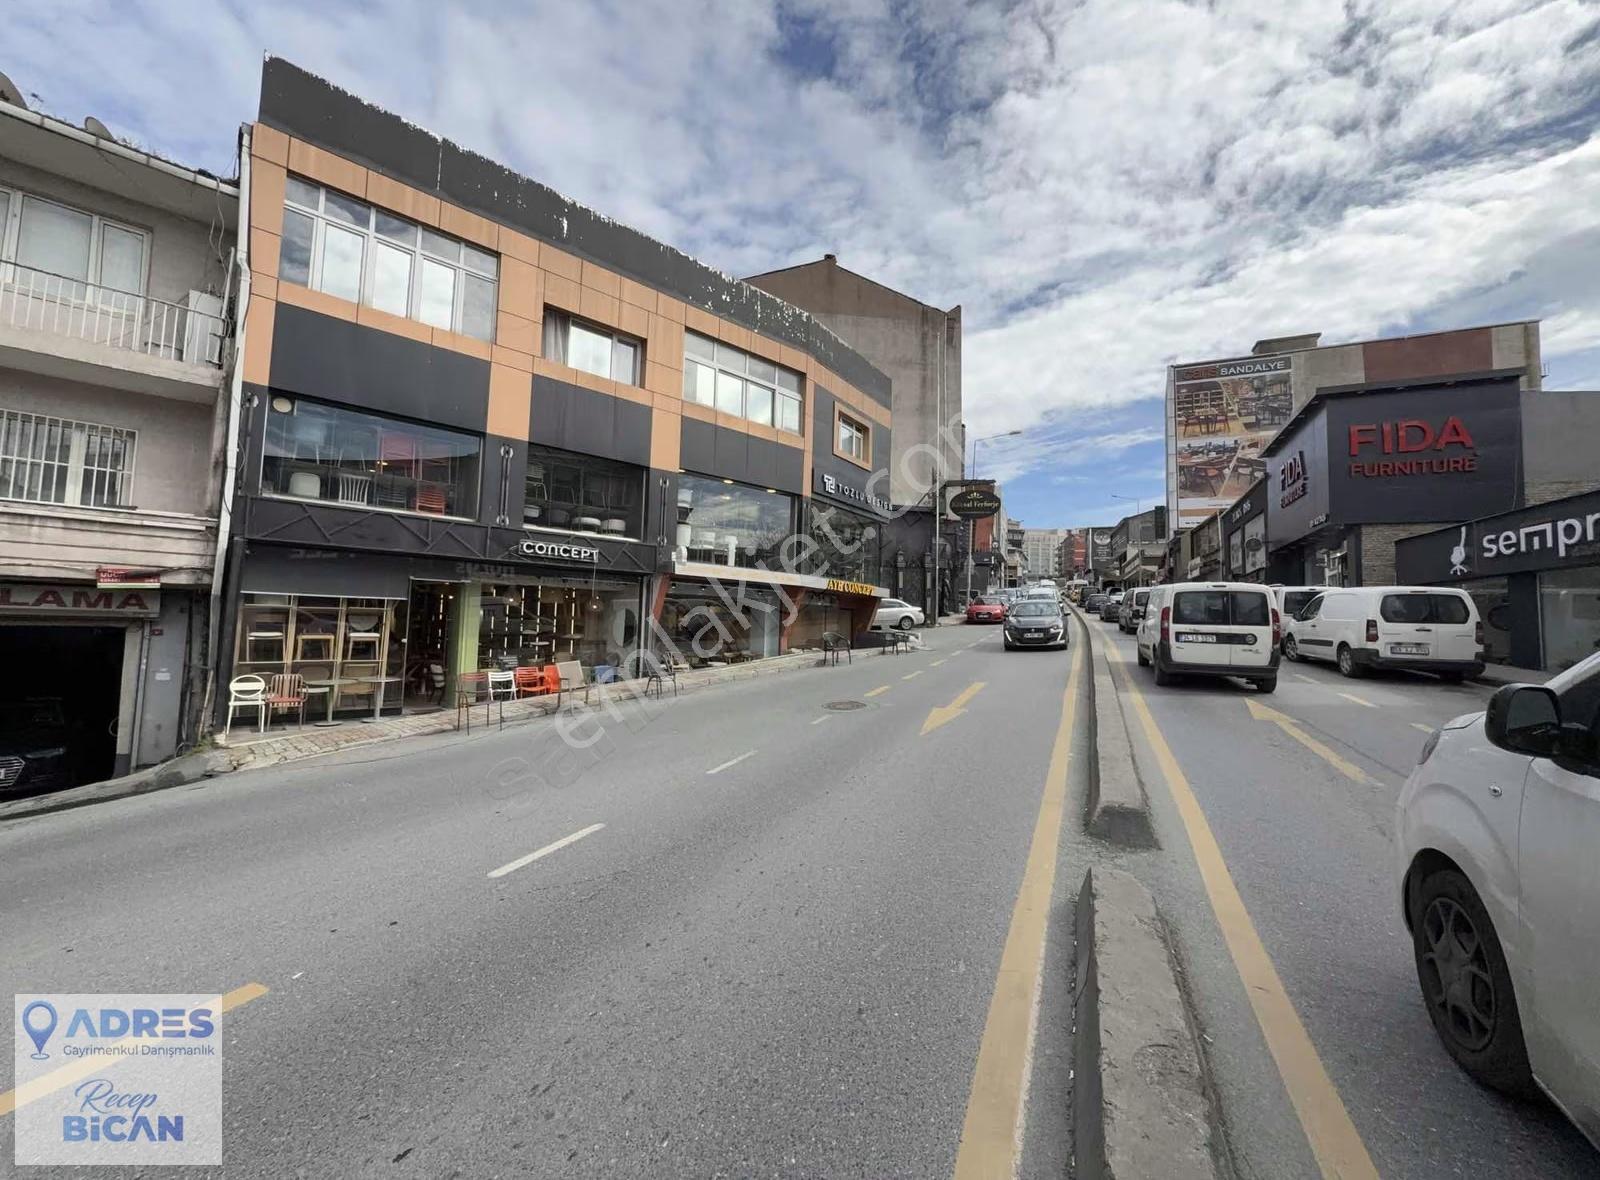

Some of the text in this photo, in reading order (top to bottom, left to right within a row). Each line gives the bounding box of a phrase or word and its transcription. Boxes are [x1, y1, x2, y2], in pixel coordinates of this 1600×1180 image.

[1220, 360, 1285, 377] SANDALYE
[1348, 416, 1474, 457] FIDA
[1280, 453, 1306, 491] FIDA
[1350, 457, 1479, 478] FURNITURE
[837, 483, 865, 501] TOZLU
[1482, 513, 1600, 557] sempr
[523, 541, 598, 562] CONCEPT
[0, 588, 148, 610] LAMA
[844, 581, 874, 597] CONCEPT
